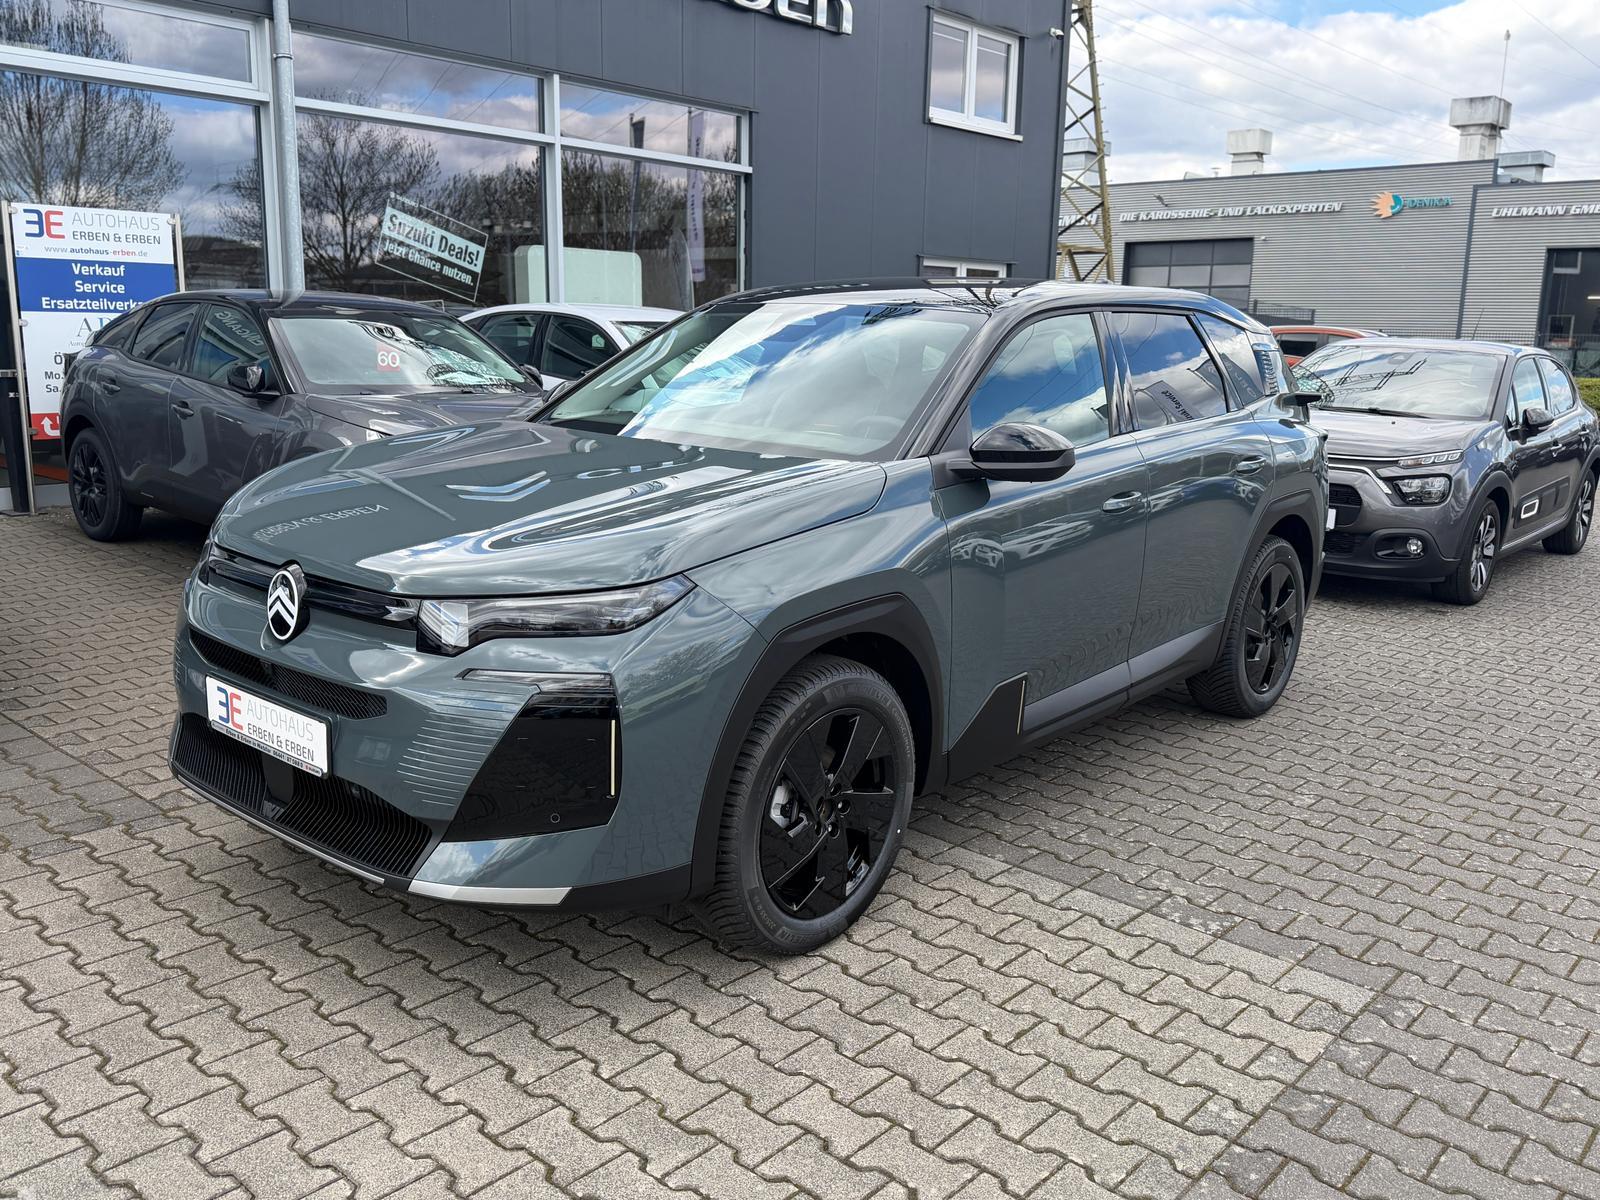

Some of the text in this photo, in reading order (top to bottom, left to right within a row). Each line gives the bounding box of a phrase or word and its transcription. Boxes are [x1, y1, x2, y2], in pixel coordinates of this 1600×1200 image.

[1119, 212, 1138, 221] DIE
[1217, 206, 1244, 217] UND
[1246, 201, 1343, 216] LACKEXPERTEN
[1491, 205, 1567, 217] UHLMANN
[71, 211, 161, 231] AUTOHAUS
[72, 230, 162, 245] ERBEN & ERBEN
[387, 213, 481, 268] Suzuki Deals!
[44, 245, 148, 258] www.autohaus-erben.de
[71, 262, 126, 277] Verkauf
[408, 248, 441, 272] Chance
[442, 264, 474, 286] nutzen.
[75, 280, 126, 294] Service
[377, 351, 400, 366] 60
[246, 699, 314, 742] AUTOHAUS
[247, 722, 275, 745] ERBEN
[276, 738, 283, 749] &
[285, 739, 315, 762] ERBEN
